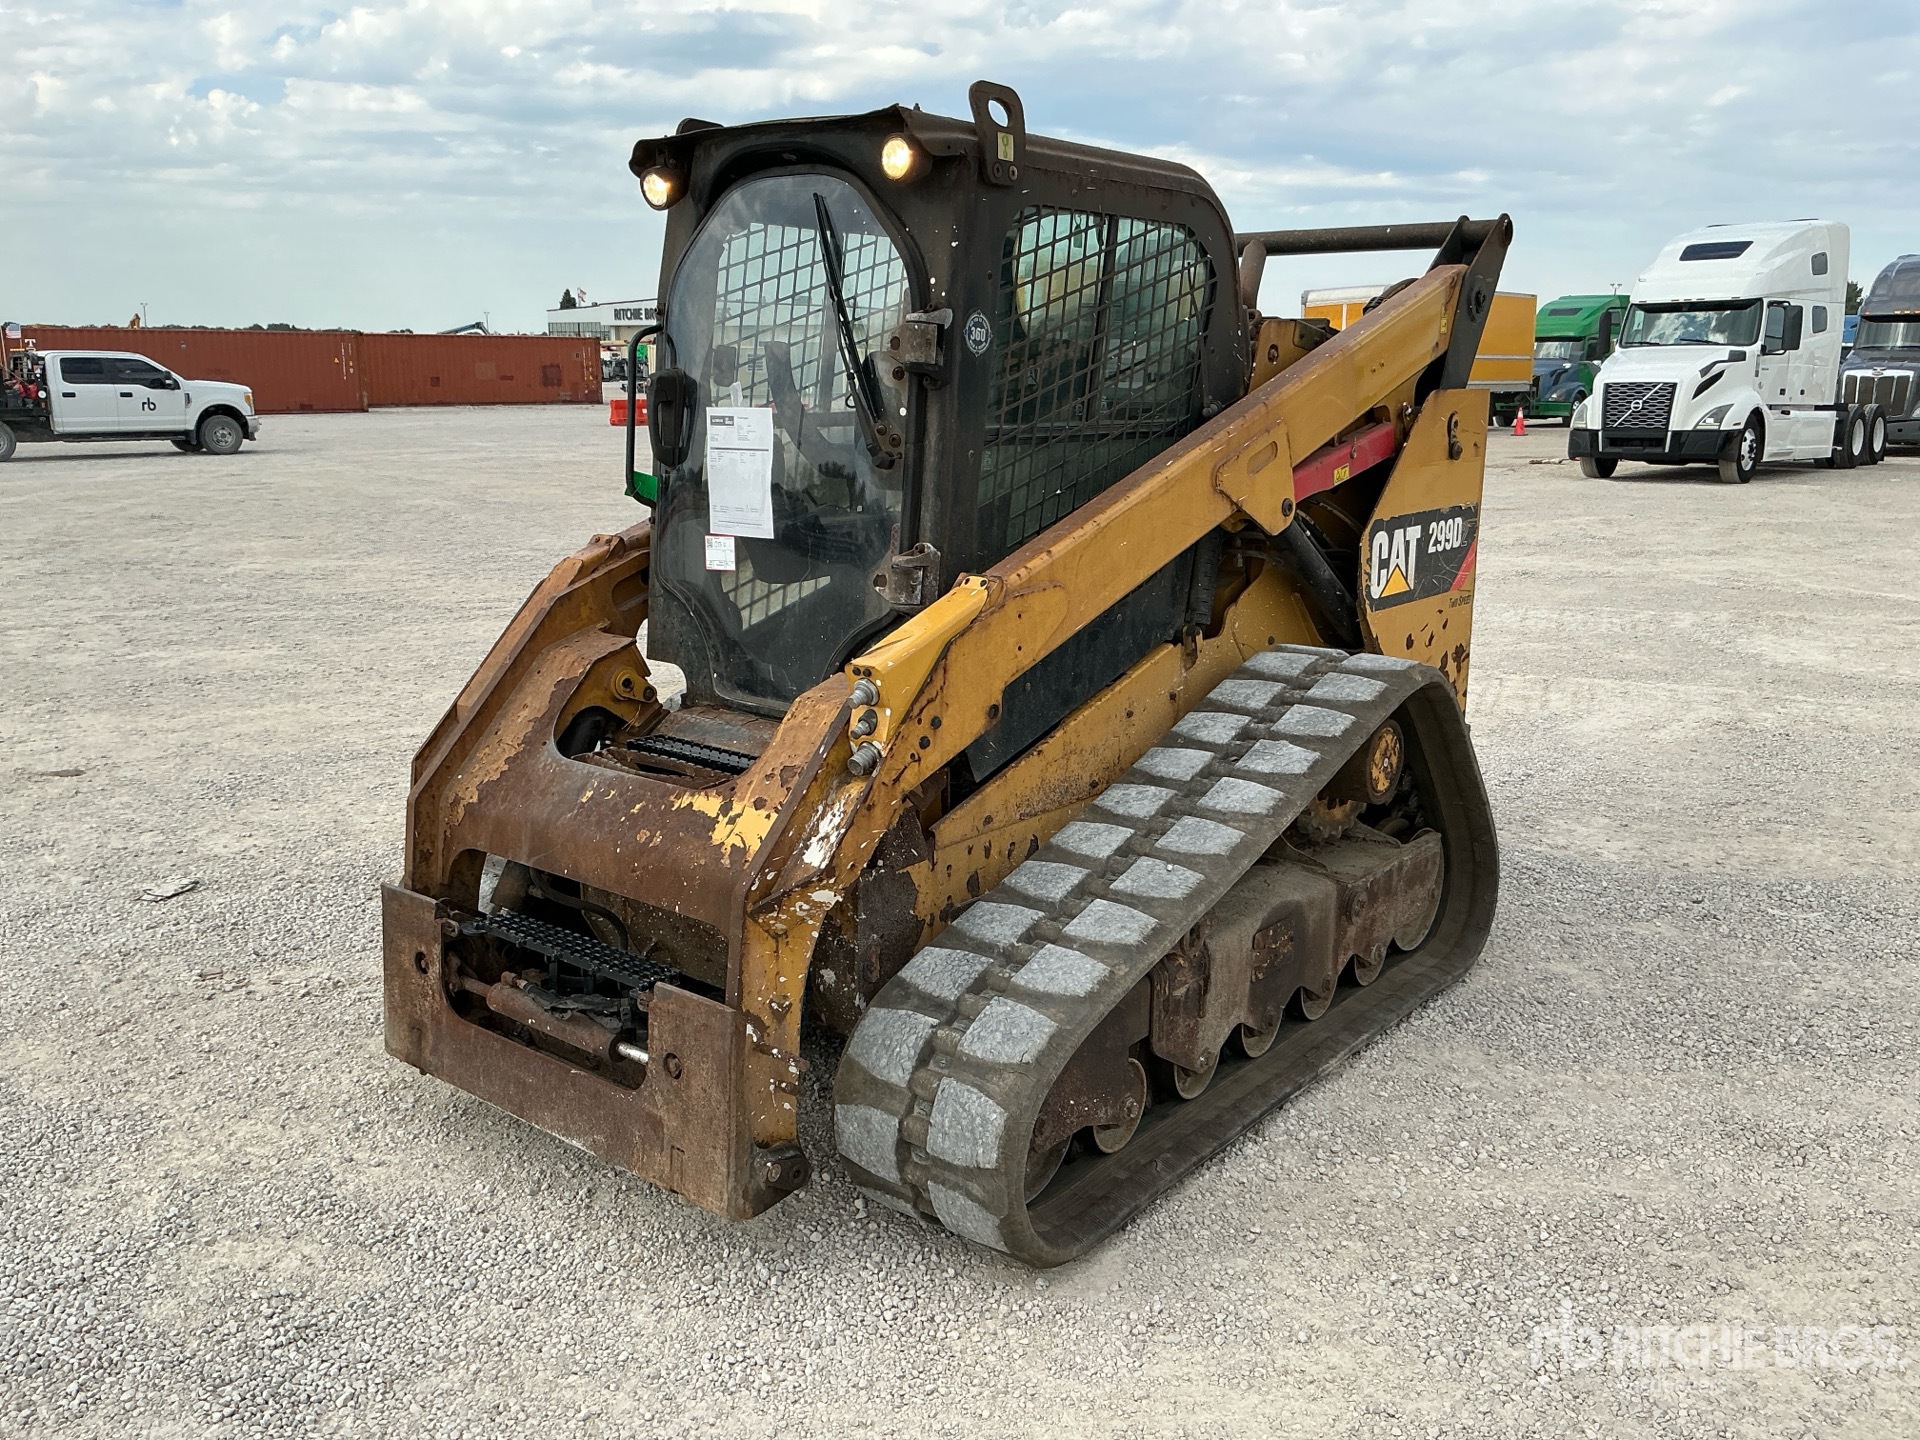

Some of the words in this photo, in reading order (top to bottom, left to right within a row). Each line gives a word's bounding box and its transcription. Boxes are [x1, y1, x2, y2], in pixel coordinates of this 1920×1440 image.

[613, 308, 643, 321] RITCHIE
[970, 326, 986, 342] 360
[142, 397, 157, 411] rb
[1370, 525, 1422, 599] CAT
